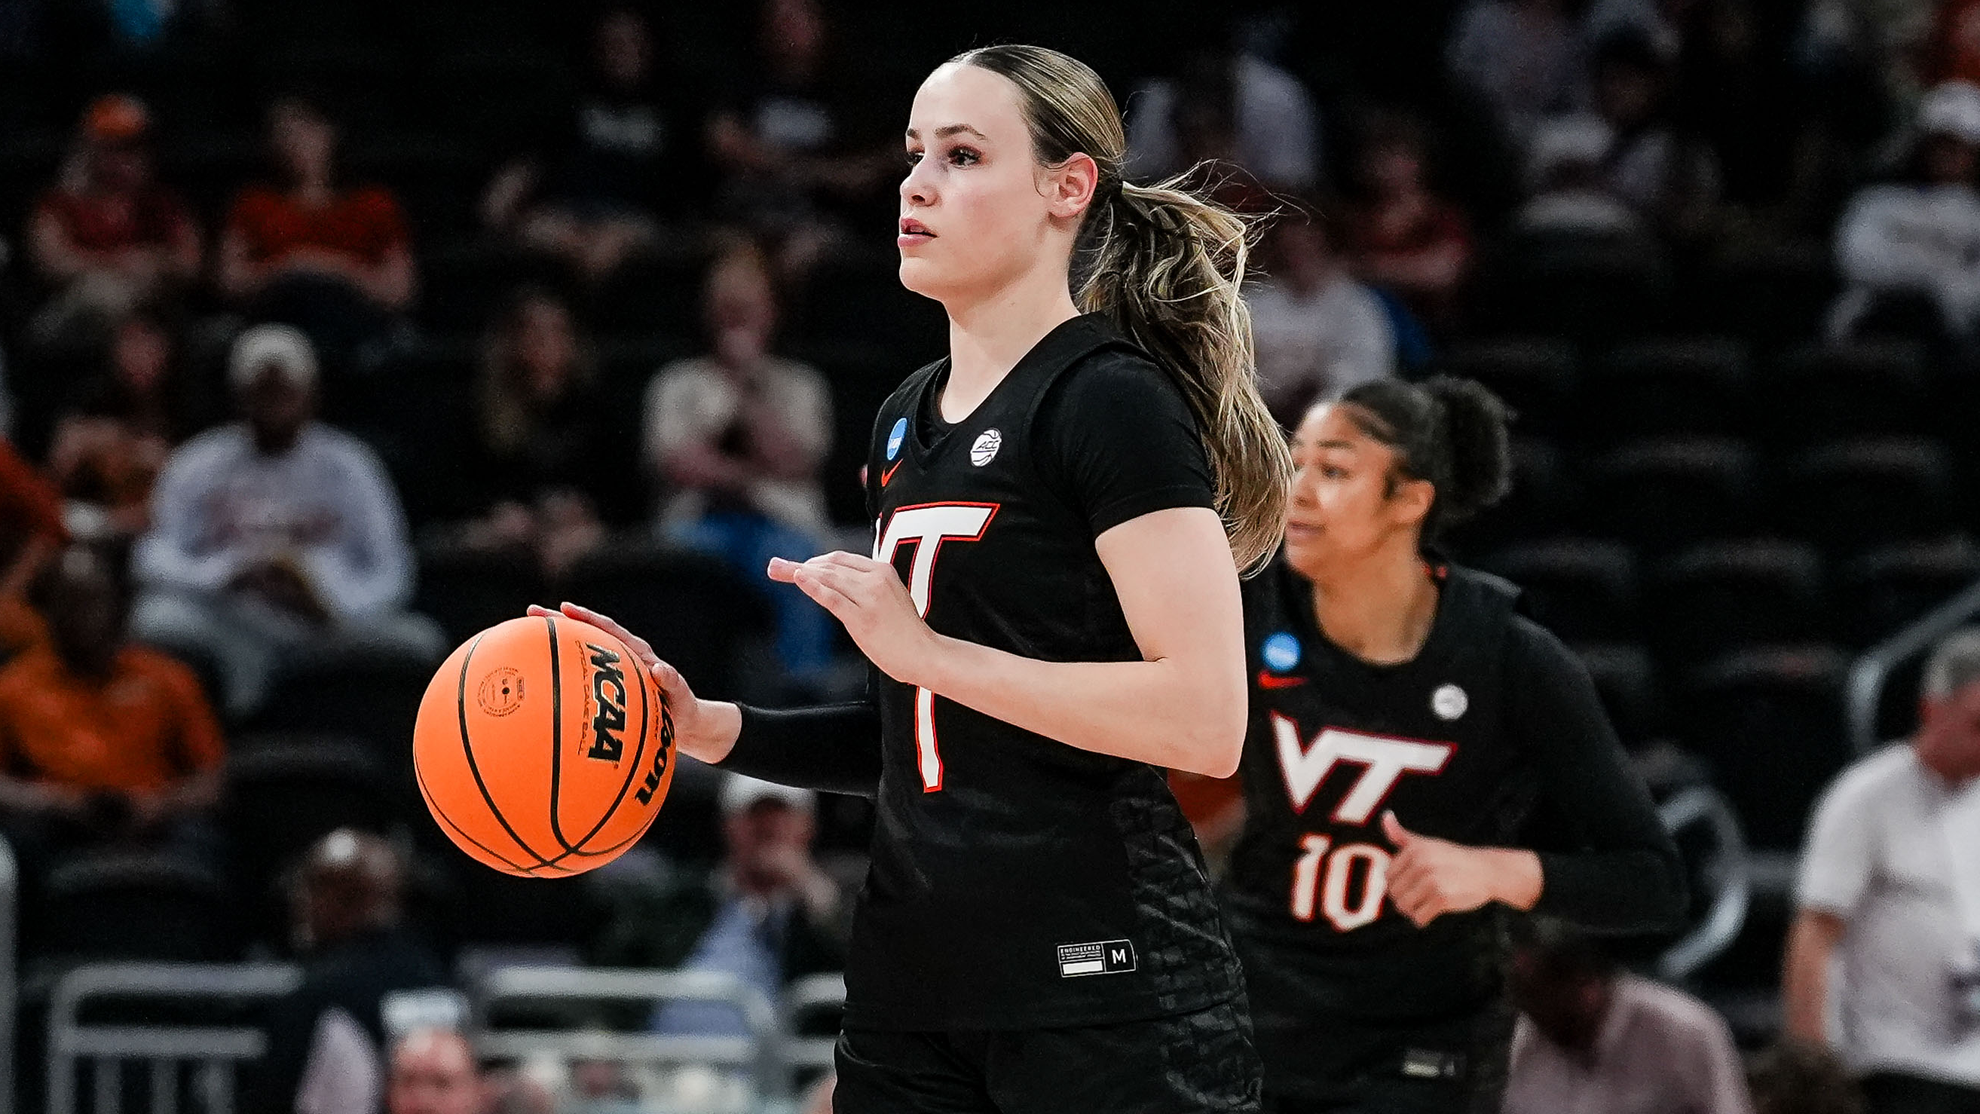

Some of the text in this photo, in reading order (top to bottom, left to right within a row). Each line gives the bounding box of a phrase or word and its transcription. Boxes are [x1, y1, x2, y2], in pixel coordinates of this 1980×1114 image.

[585, 641, 627, 762] NCAA
[1270, 709, 1458, 828] VT
[1290, 831, 1393, 933] 10
[1111, 948, 1127, 965] M
